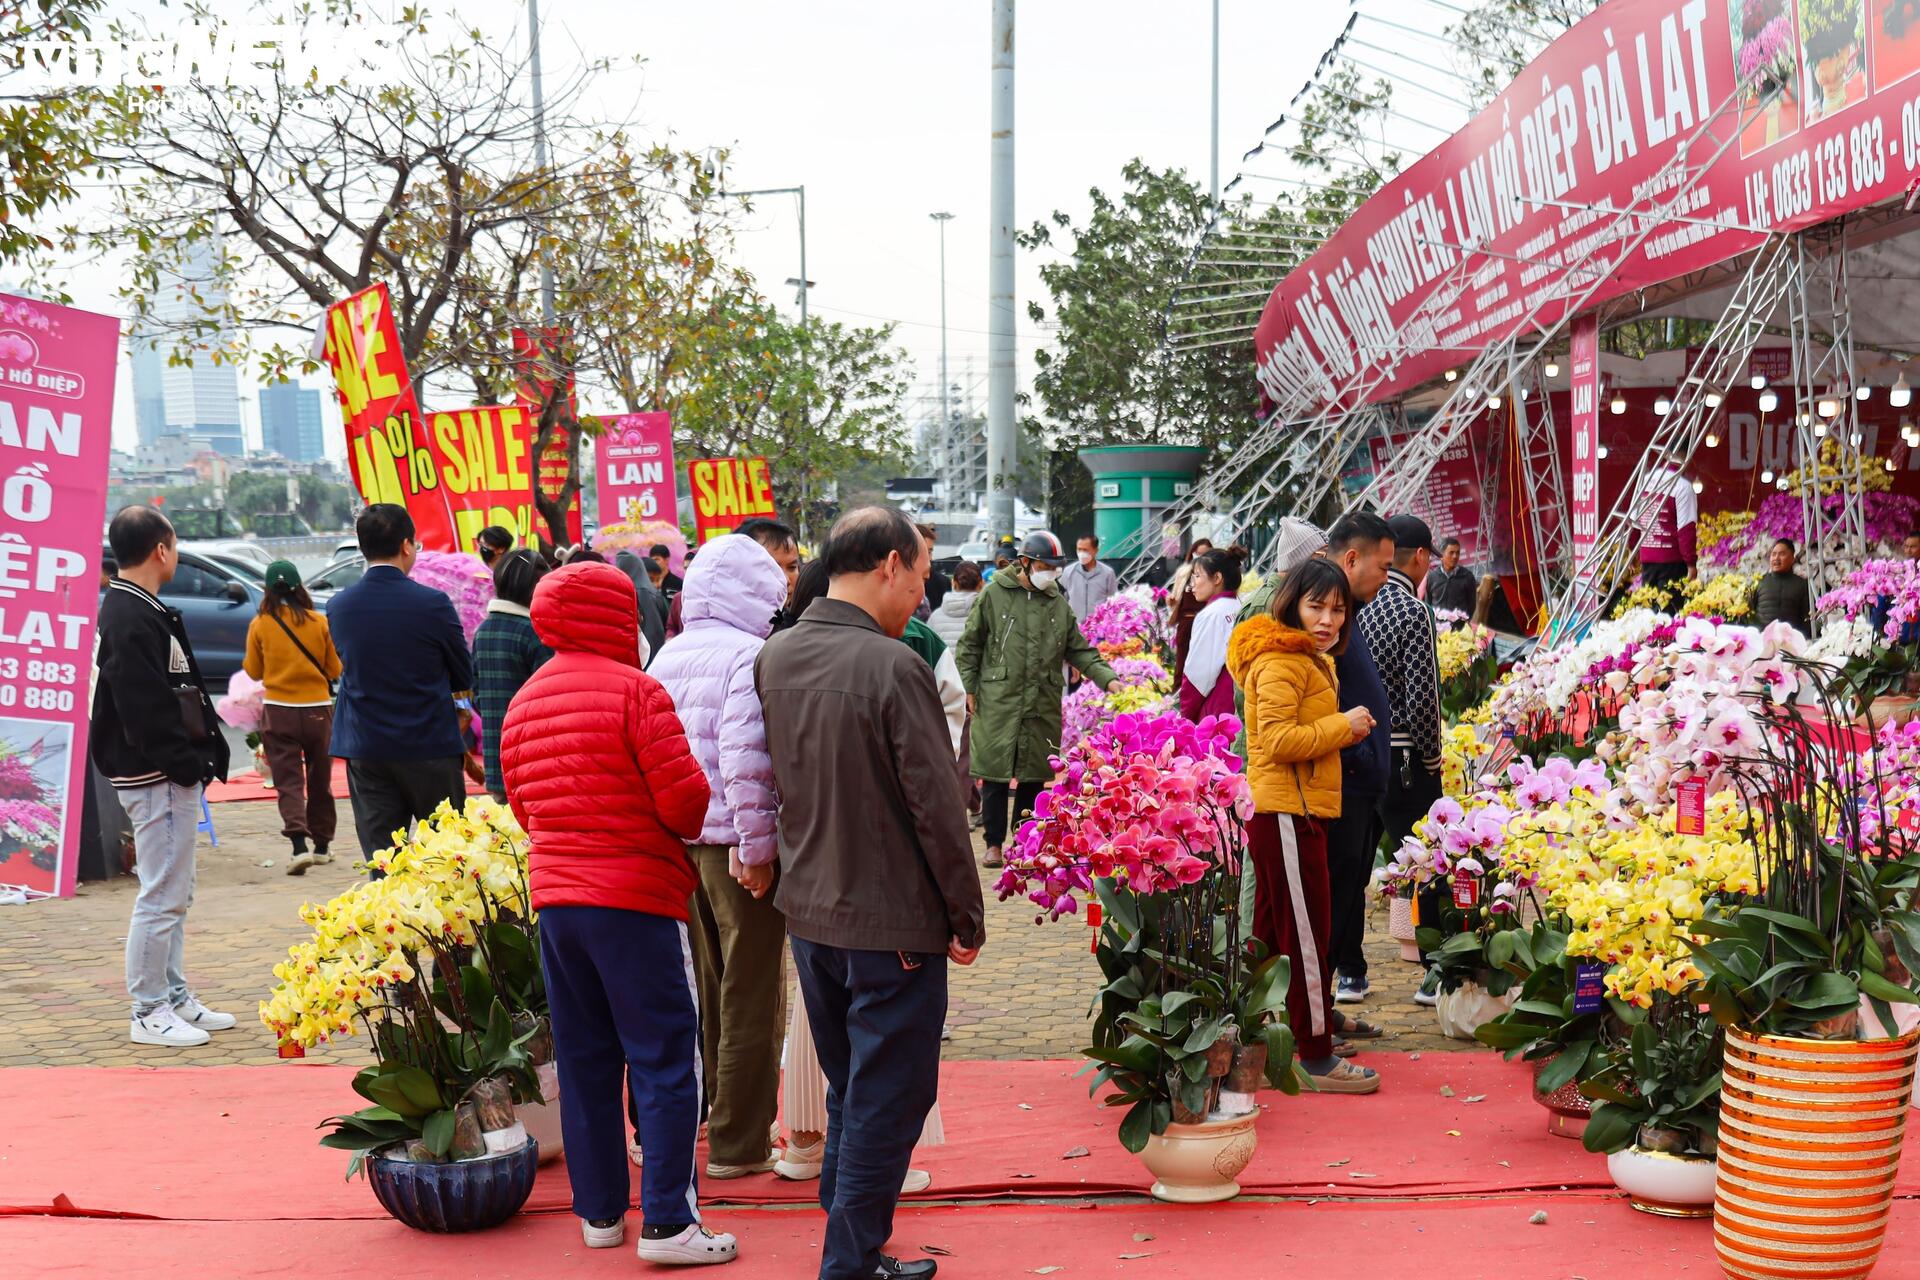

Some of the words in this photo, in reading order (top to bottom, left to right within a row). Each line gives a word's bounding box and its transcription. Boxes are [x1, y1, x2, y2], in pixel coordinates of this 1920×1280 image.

[1446, 153, 1495, 258] LAN
[1520, 74, 1578, 217] ĐIỆP
[1582, 27, 1638, 175] ĐÀ
[1745, 170, 1771, 233] LH:
[1772, 149, 1812, 223] 0833
[1815, 133, 1847, 205] 133
[1850, 115, 1885, 192] 883
[1574, 383, 1592, 415] LAN
[434, 408, 529, 494] SALE
[607, 461, 663, 486] LAN
[694, 460, 774, 517] SALE
[26, 660, 76, 685] 883
[24, 686, 74, 712] 880
